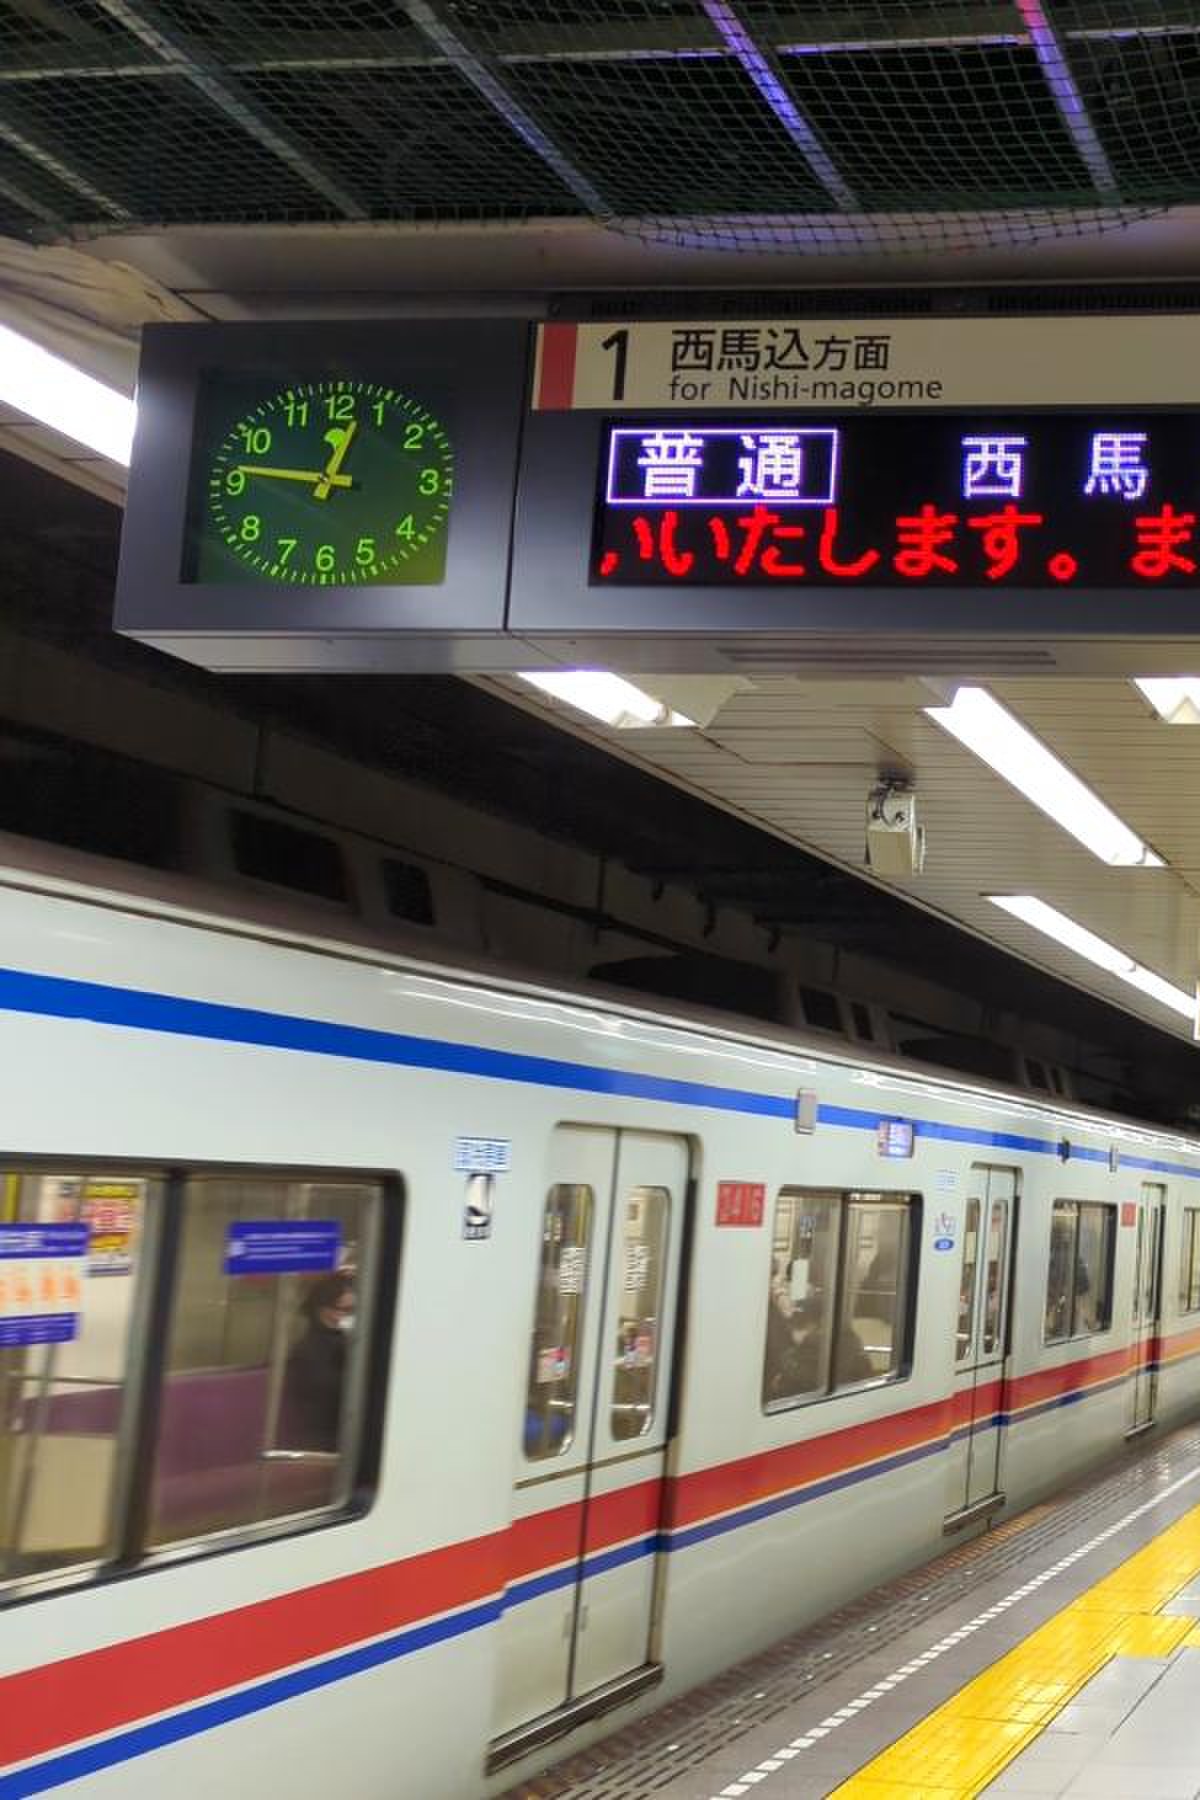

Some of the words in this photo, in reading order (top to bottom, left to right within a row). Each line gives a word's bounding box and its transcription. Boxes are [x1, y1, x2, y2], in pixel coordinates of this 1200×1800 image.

[671, 328, 891, 371] 西馬込方面
[601, 330, 630, 400] 1
[670, 376, 710, 401] for
[730, 376, 943, 405] Nishi-magome
[285, 404, 307, 426] 11
[326, 396, 354, 419] 12
[373, 402, 385, 424] 1
[246, 430, 271, 453] 10
[405, 426, 423, 449] 2
[637, 433, 800, 497] 普通
[227, 472, 246, 496] 9
[419, 471, 438, 493] 3
[242, 516, 260, 541] 8
[397, 515, 414, 539] 4
[278, 540, 296, 564] 7
[316, 545, 334, 569] 6
[356, 539, 374, 565] 5
